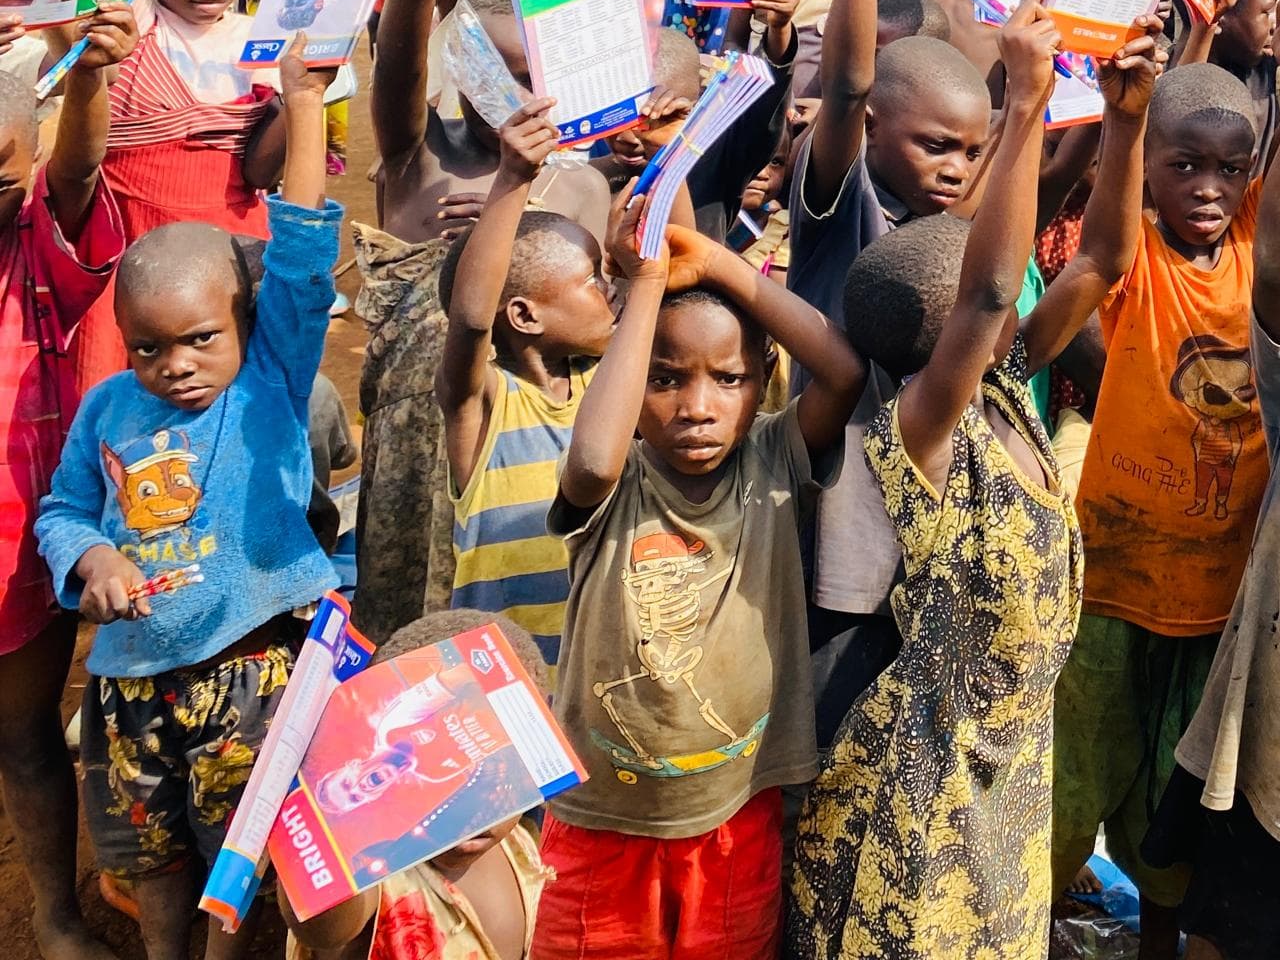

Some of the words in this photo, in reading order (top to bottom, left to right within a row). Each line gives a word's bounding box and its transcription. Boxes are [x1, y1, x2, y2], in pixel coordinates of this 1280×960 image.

[303, 41, 340, 55] BRIG
[120, 535, 217, 563] CHASE
[280, 803, 333, 891] BRIGHT
